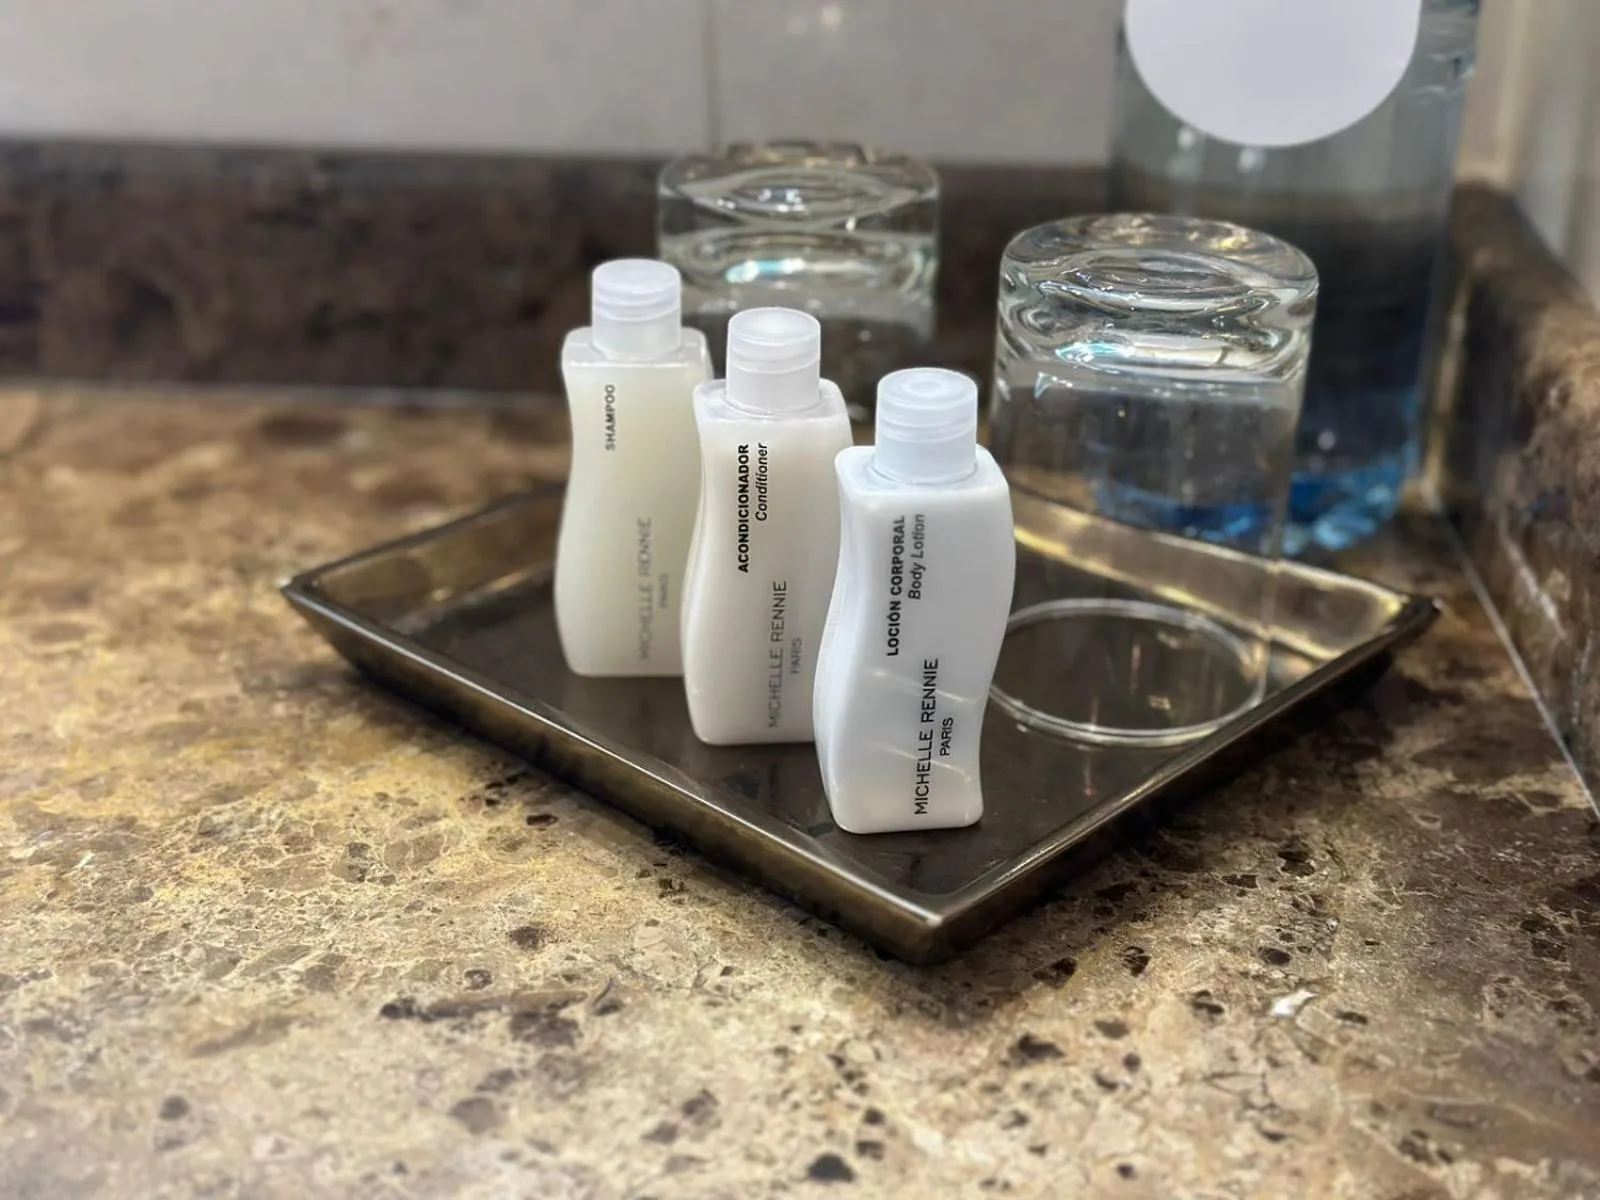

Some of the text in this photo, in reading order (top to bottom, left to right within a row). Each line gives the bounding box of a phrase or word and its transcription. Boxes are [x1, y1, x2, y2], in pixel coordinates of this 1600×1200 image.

[604, 384, 616, 451] SHAMPOO
[737, 443, 750, 573] ACONDICIONADOR
[755, 442, 769, 522] Conditioner
[637, 517, 653, 662] MICHELLE RENNIE
[658, 572, 669, 609] PARIS
[886, 514, 906, 657] LOCIÓN CORPORAL
[908, 513, 926, 600] Body Lotion
[768, 580, 788, 728] MICHELLE RENNIE
[790, 636, 802, 674] PARIS
[914, 658, 939, 816] MICHELLE RENNIE
[940, 717, 954, 756] PARIS
